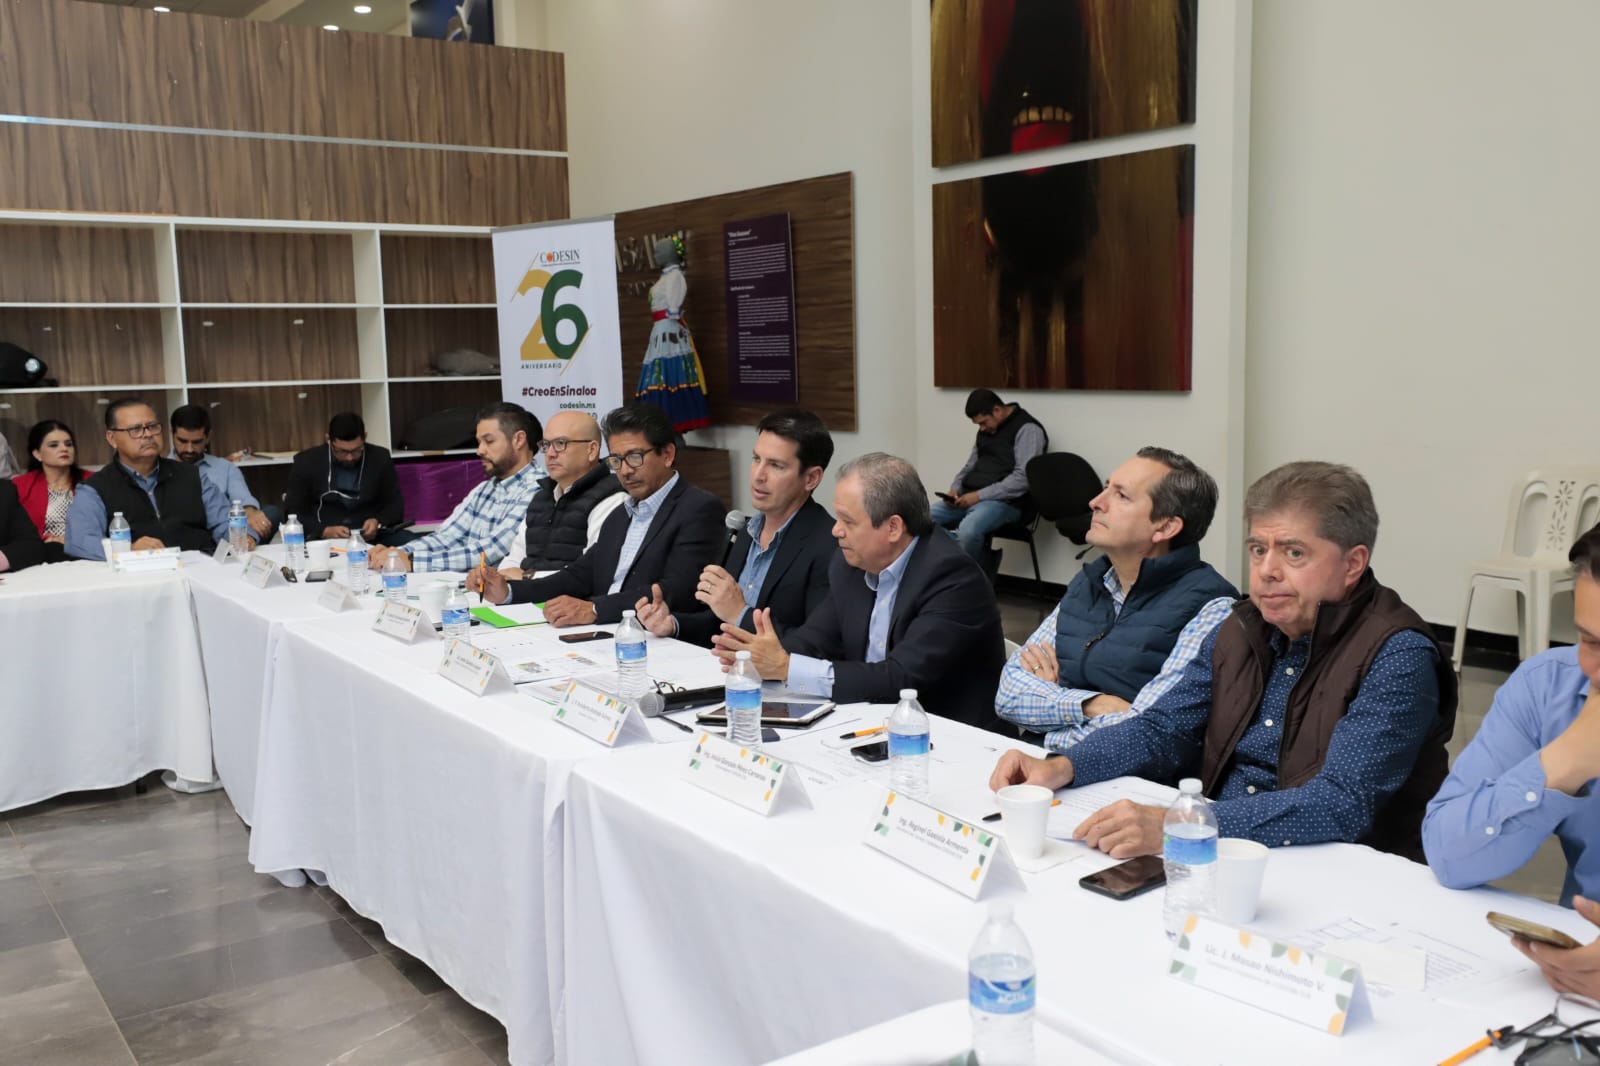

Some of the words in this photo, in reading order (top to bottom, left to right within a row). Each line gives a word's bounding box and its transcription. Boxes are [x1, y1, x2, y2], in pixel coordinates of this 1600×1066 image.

[540, 249, 580, 263] CODESIN
[517, 269, 589, 360] 26
[522, 384, 597, 397] #CreoEnSinaloa
[559, 400, 596, 409] codesin.mx
[1264, 963, 1314, 988] Nishimoto
